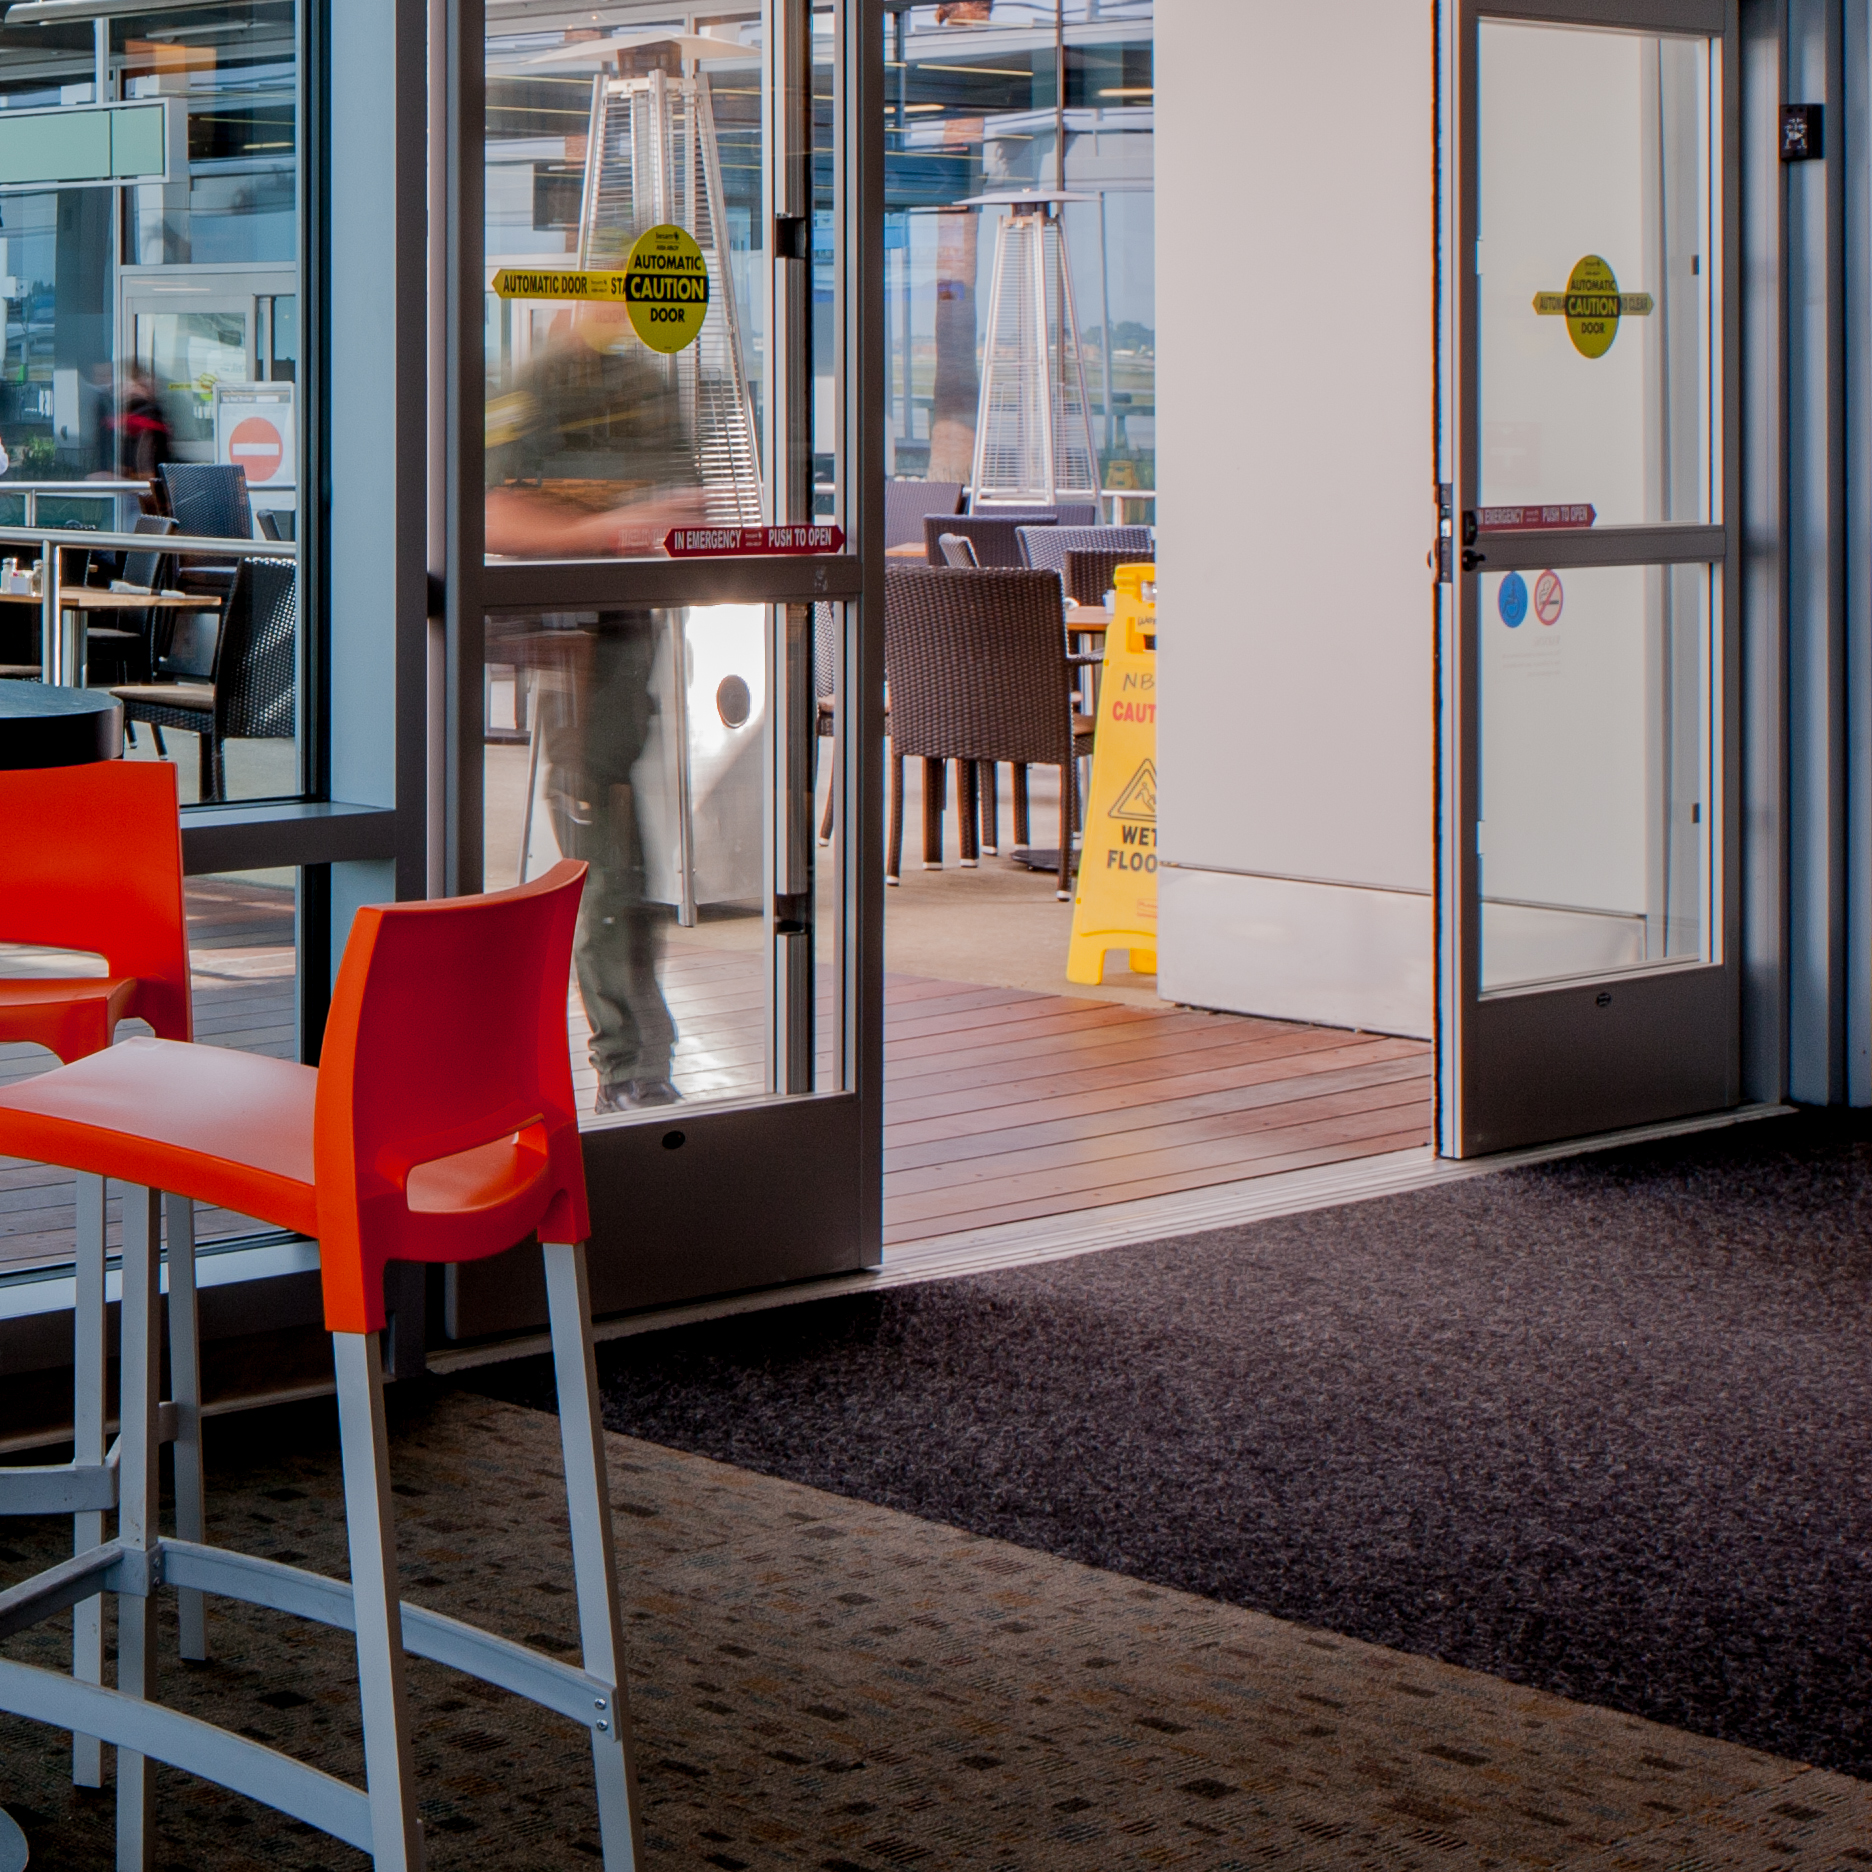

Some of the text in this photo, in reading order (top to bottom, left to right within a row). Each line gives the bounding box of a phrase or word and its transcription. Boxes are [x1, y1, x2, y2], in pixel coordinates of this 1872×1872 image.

[634, 255, 702, 271] AUTOMATIC
[503, 275, 559, 294] AUTOMATIC
[561, 276, 588, 294] DOOR
[630, 276, 704, 301] CAUTION
[650, 307, 685, 322] DOOR
[1567, 297, 1618, 316] CAUTION
[1581, 322, 1605, 334] DOOR
[674, 531, 685, 550] IN
[686, 530, 742, 550] EMERGENCY
[768, 528, 792, 548] PUSH
[794, 528, 806, 547] TO
[808, 527, 832, 547] OPEN
[1112, 700, 1157, 724] CAUT
[1122, 825, 1157, 847] WET
[1106, 849, 1157, 874] FLOO
